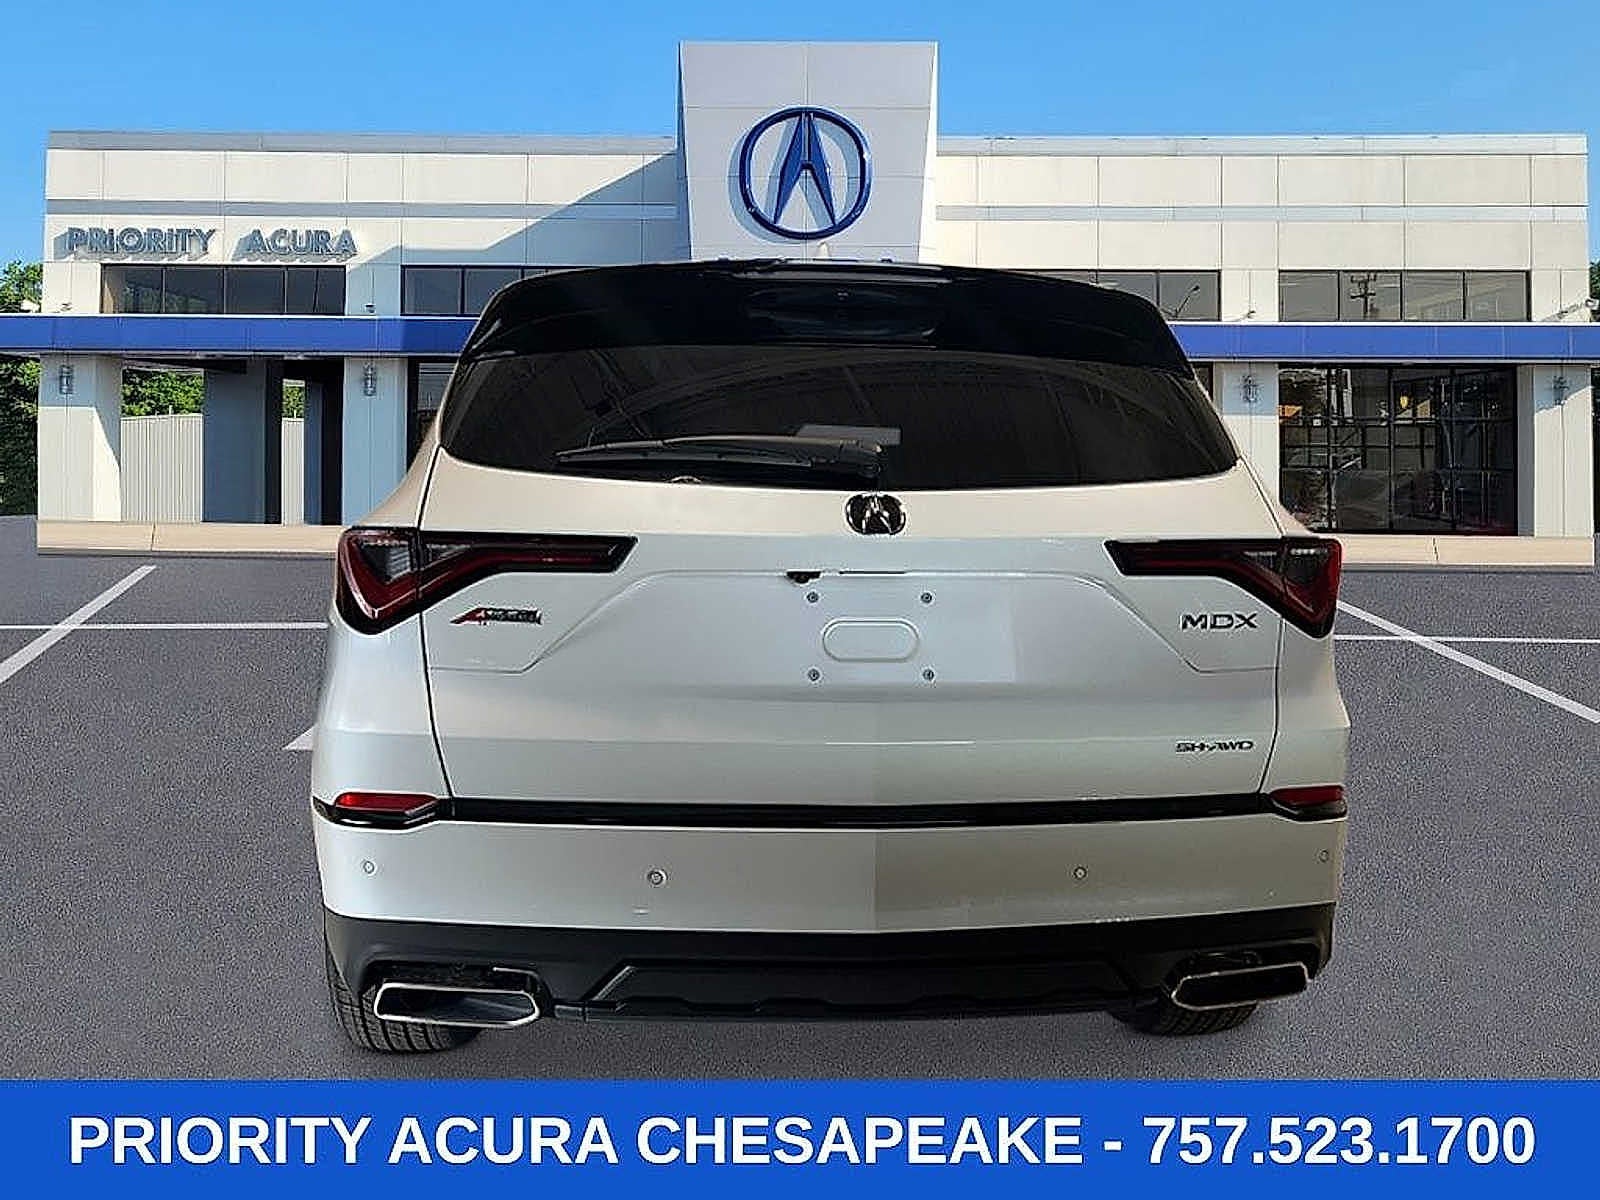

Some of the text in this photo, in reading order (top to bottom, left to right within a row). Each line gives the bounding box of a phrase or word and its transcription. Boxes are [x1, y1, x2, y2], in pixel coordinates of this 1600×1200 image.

[66, 227, 357, 256] PRIORITY ACURA
[1181, 613, 1257, 630] MDX
